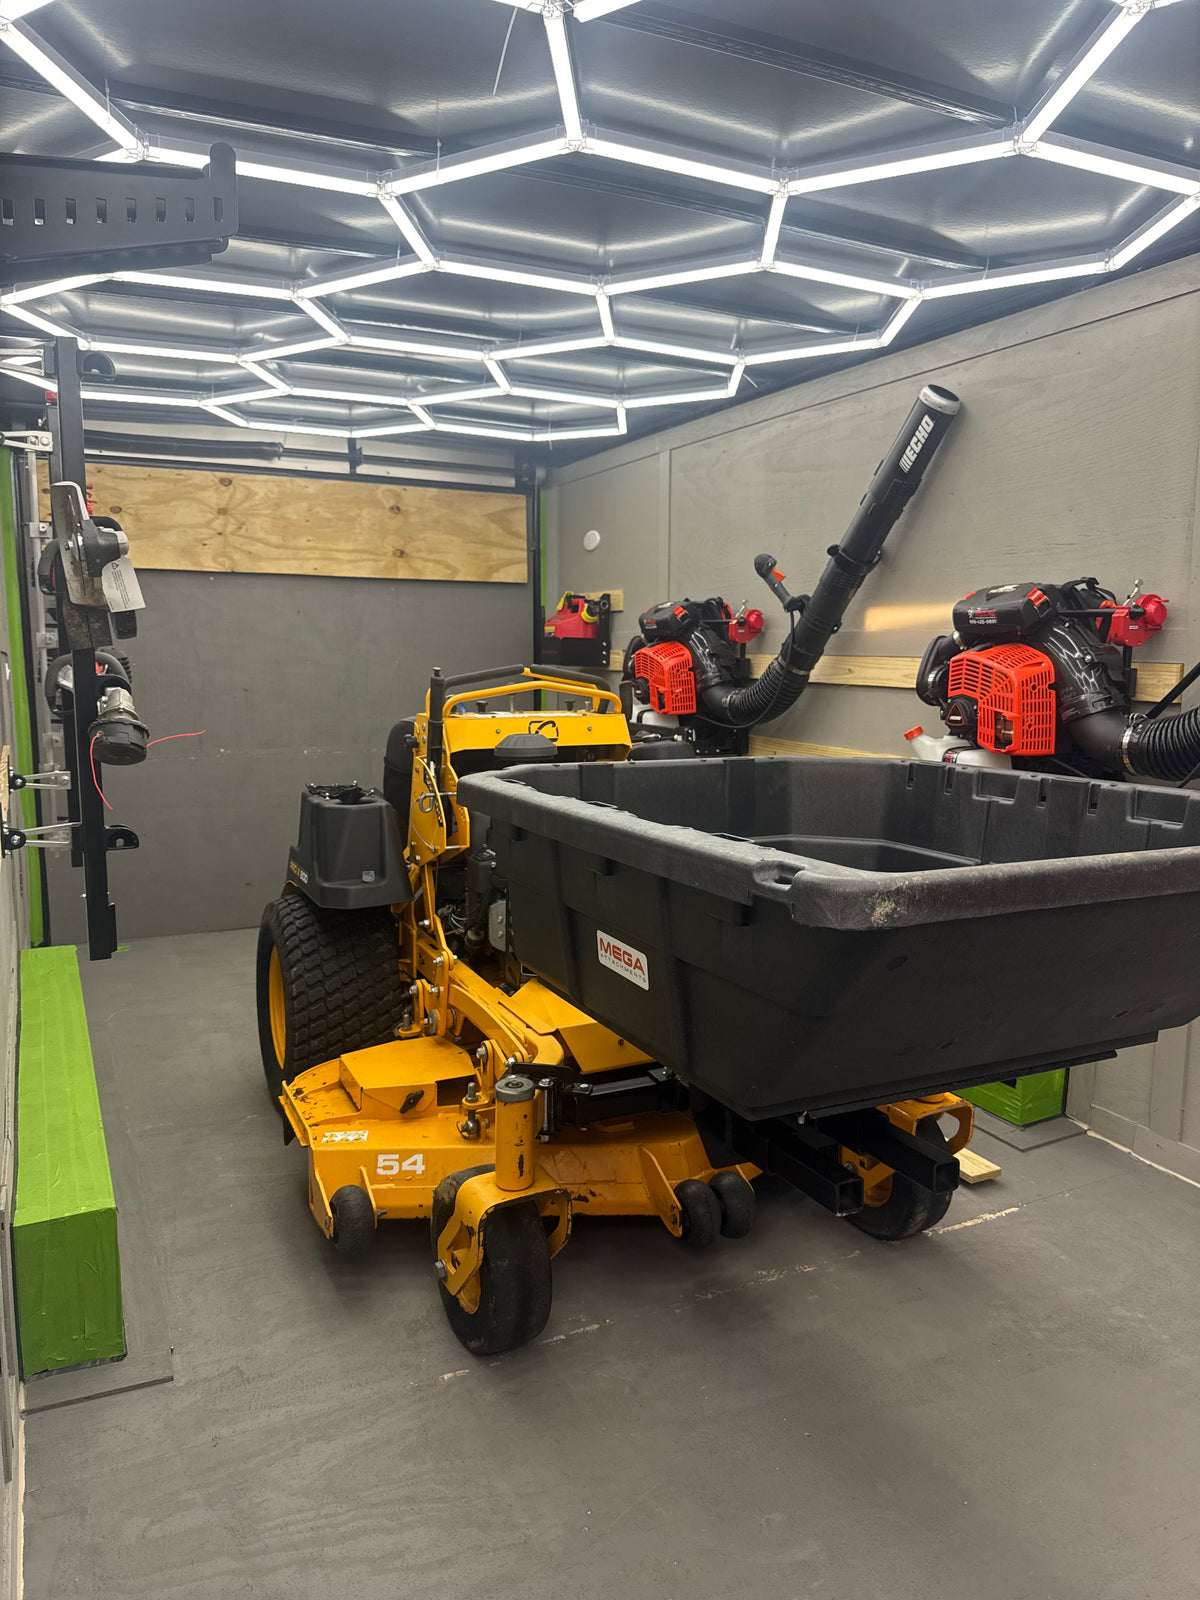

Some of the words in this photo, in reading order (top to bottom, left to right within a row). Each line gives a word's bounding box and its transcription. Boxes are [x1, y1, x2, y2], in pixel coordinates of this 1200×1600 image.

[900, 415, 935, 471] ECHO
[600, 937, 646, 976] MEGA
[600, 953, 646, 983] ATTACHMENTS
[376, 1153, 426, 1175] 54
